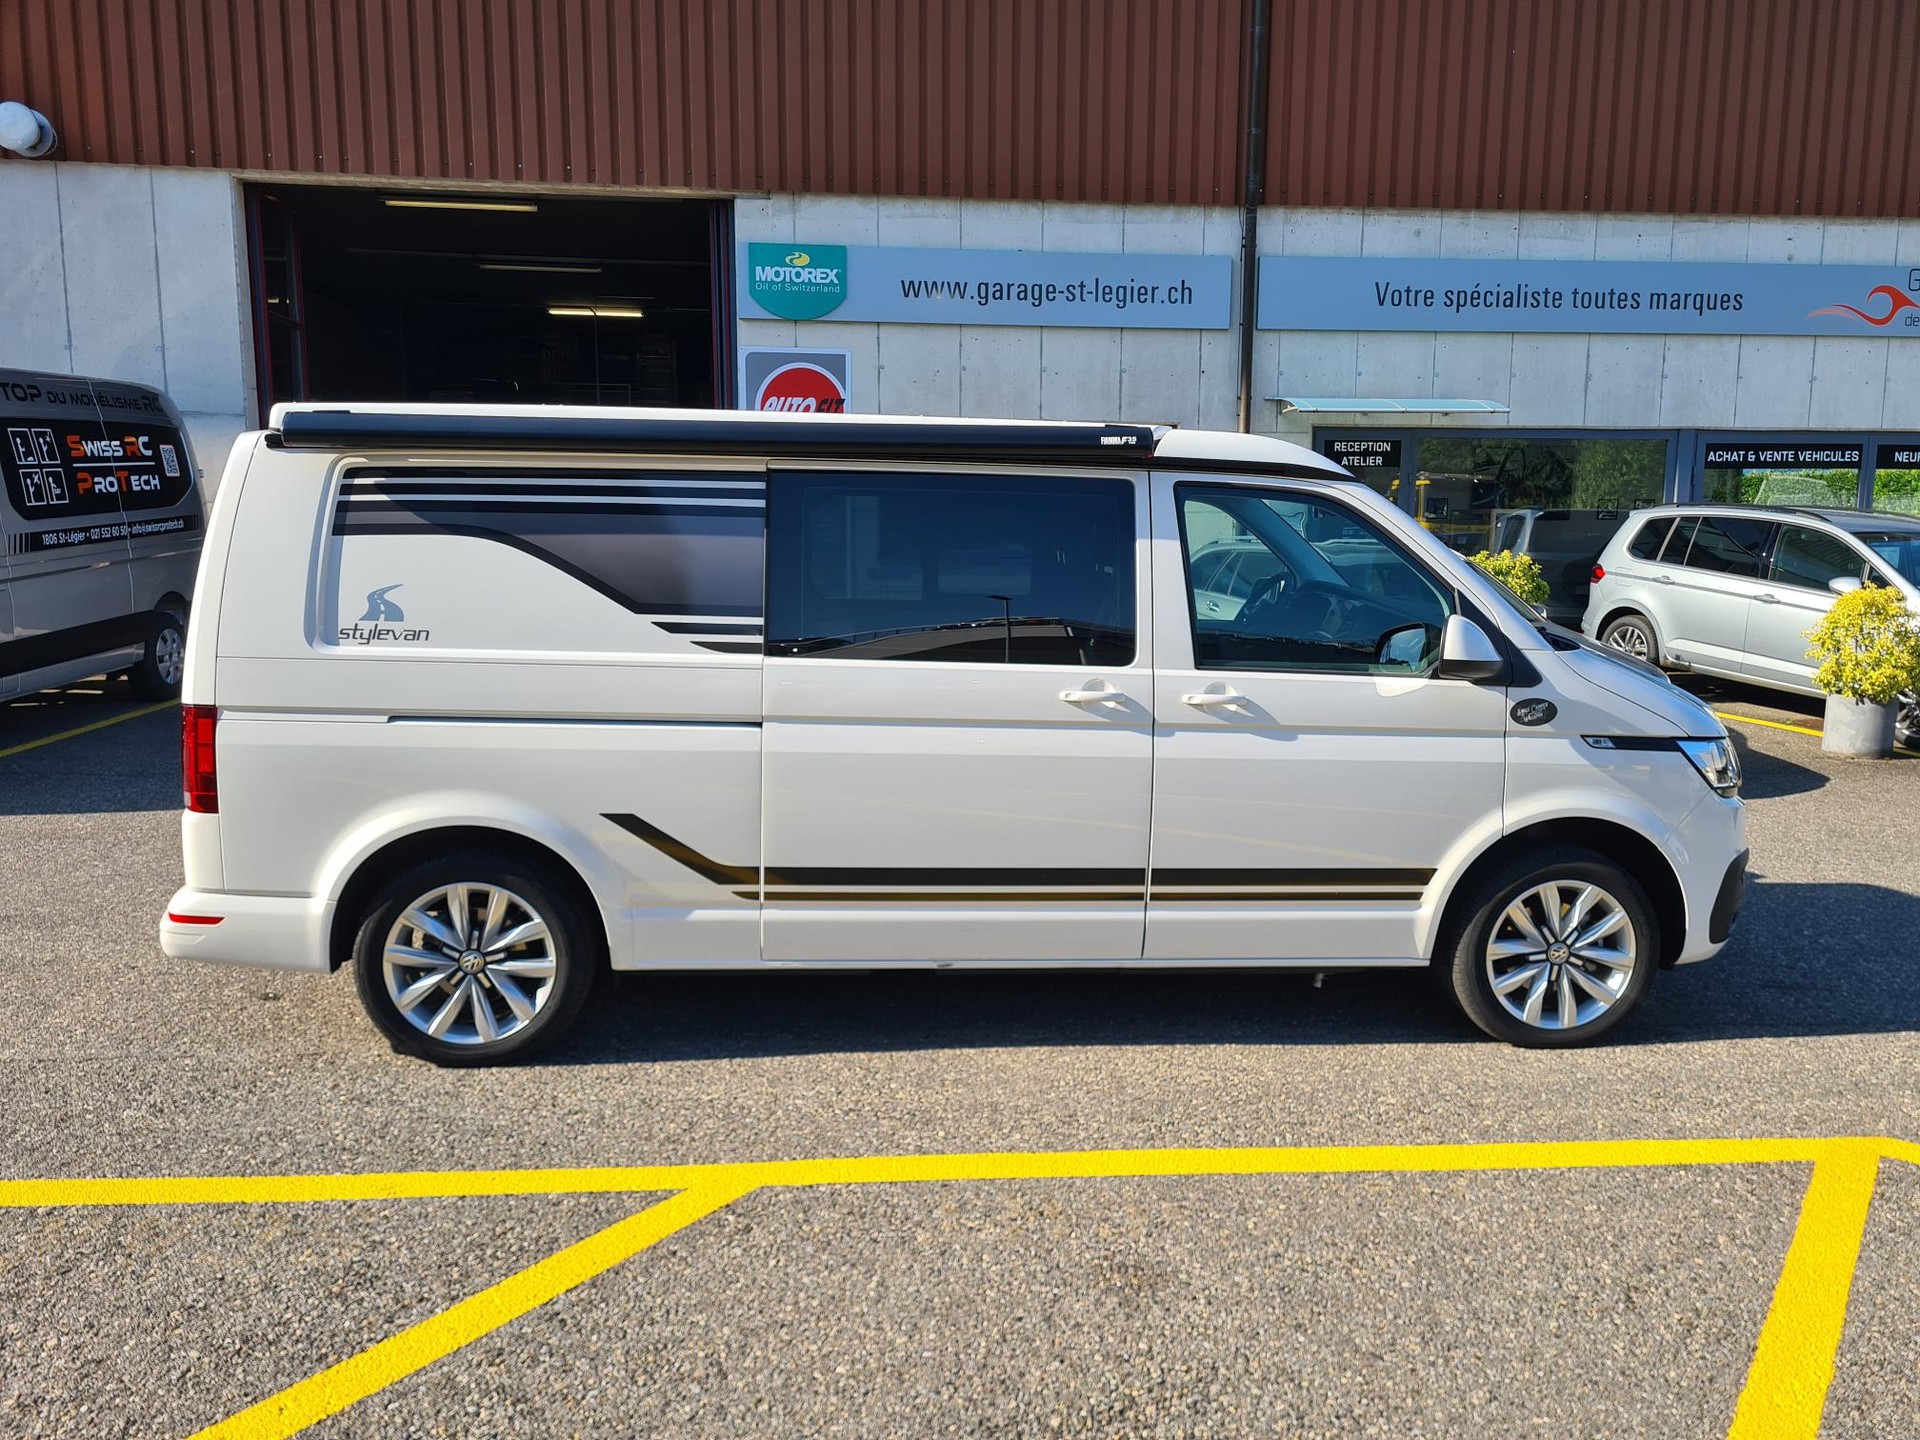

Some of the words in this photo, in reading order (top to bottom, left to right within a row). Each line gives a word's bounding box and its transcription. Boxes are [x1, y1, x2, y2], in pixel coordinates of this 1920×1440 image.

[755, 266, 839, 284] MOTOREX
[755, 282, 769, 290] Oil
[785, 283, 840, 293] Switzerland
[901, 277, 1193, 309] www.garage-st-legier.ch
[1375, 281, 1434, 307] Votre
[1443, 282, 1563, 313] spécialiste
[1571, 286, 1641, 310] toutes
[1649, 290, 1744, 316] marques
[124, 435, 153, 456] RC
[1334, 442, 1391, 452] RECEPTION
[1341, 456, 1383, 466] ATELIER
[1707, 451, 1745, 462] ACHAT
[1747, 451, 1756, 462] &
[1759, 452, 1795, 462] VENTE
[1798, 451, 1860, 462] VEHICULES
[42, 534, 58, 546] 1806
[90, 529, 101, 539] 021
[101, 527, 112, 538] 552
[338, 623, 430, 645] stylevan
